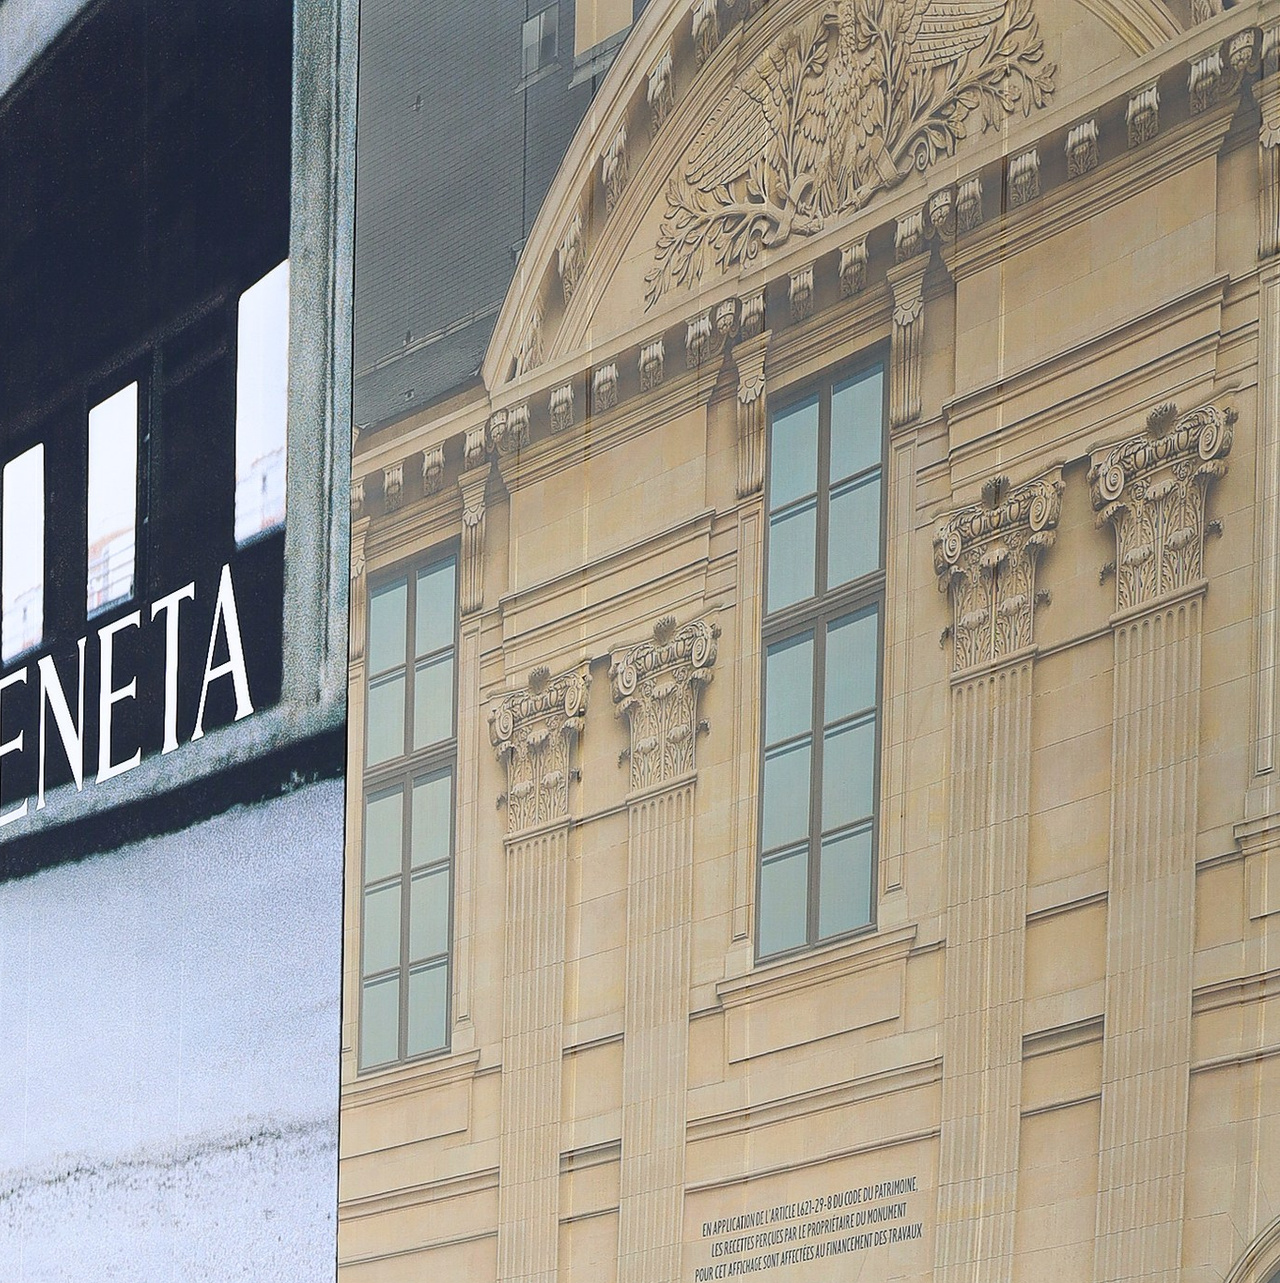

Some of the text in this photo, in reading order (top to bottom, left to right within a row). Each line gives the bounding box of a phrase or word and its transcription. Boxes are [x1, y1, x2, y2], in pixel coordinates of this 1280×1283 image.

[702, 1222, 712, 1238] EN
[712, 1214, 755, 1236] APPLICATION
[756, 1210, 764, 1226] DE
[833, 1193, 843, 1209] DU
[844, 1188, 862, 1206] CODE
[863, 1185, 873, 1202] DU
[711, 1202, 907, 1257] LES RECETTES PERÇUES PAR LE PROPRIÉTAIRE DU MONUMENT
[694, 1222, 923, 1283] POUR CET AFFICHAGE SONT AFFECTÉES AU FINANCEMENT DES TRAVAUX
